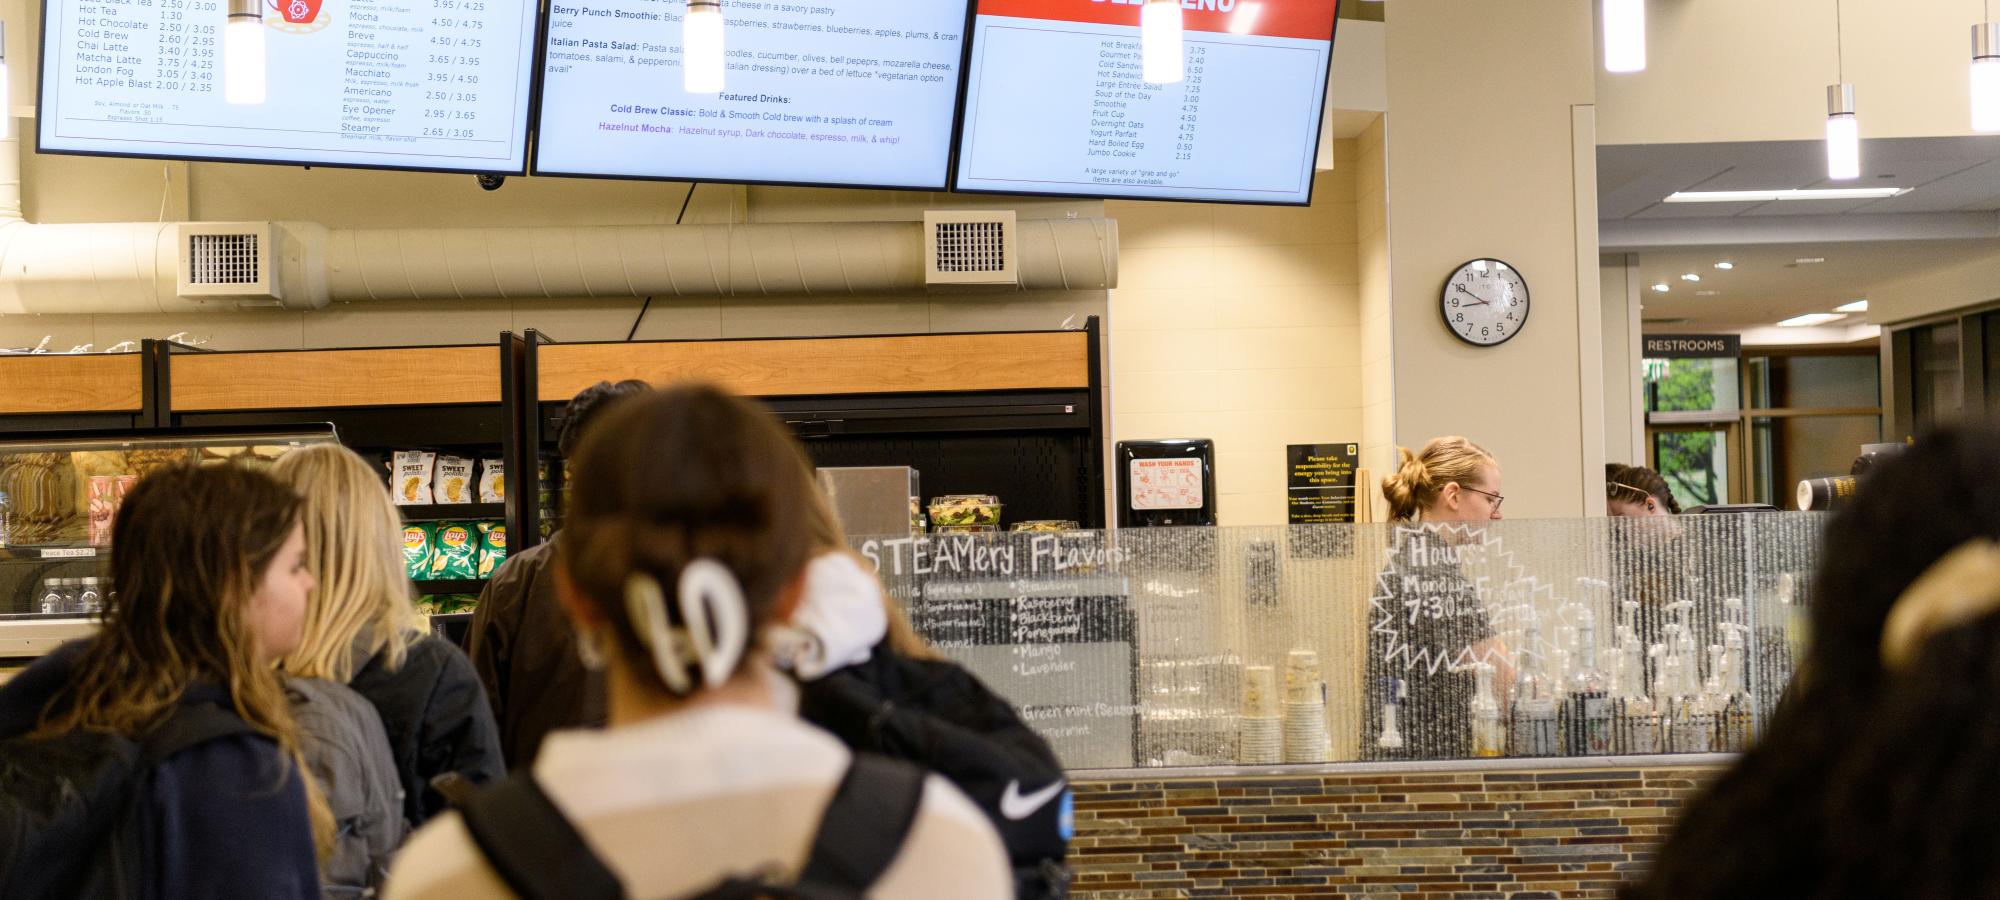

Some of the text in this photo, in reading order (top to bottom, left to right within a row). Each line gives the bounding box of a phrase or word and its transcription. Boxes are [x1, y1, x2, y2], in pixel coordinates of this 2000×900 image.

[80, 5, 182, 20] Hot Tea 1.30
[782, 4, 835, 16] savory pastry
[79, 17, 215, 34] Hot Chocolate 2.50 3.05
[350, 12, 483, 29] Mocha 4.50 4.75
[552, 19, 572, 28] juice
[554, 5, 579, 17] Berry
[582, 8, 611, 17] Punch
[615, 10, 662, 20] Smoothie:
[772, 22, 824, 32] strawberries,
[827, 25, 873, 35] blueberries,
[875, 29, 902, 38] apples,
[78, 29, 214, 46] Cold Brew 2.60 2.95
[348, 31, 375, 40] Breve
[77, 41, 214, 57] Chai Latte 3.40 3.95
[551, 37, 579, 47] Italian
[582, 39, 608, 48] Pasta
[611, 41, 639, 51] Salad:
[643, 43, 667, 53] Pasta
[758, 51, 799, 61] cucumber,
[830, 55, 844, 63] bell
[923, 61, 952, 71] cheese,
[77, 53, 213, 69] Matcha Latte 3.75 4.25
[347, 50, 398, 61] Cappuccino
[1100, 51, 1204, 64] Gourmet 2.40
[77, 65, 212, 80] London Fog 3.05 3.40
[345, 68, 391, 78] Macchiato
[549, 52, 592, 61] tomatoes,
[595, 55, 625, 64] salami,
[920, 74, 944, 83] option
[76, 76, 211, 92] Hot Apple Blast 2.00 2.35
[1096, 80, 1114, 89] Large
[344, 87, 392, 97] Americano
[719, 92, 791, 103] Featured Drinks:
[1095, 90, 1112, 98] Soup
[343, 105, 396, 117] Eye Opener
[611, 104, 632, 114] Cold
[635, 106, 657, 115] Brew
[661, 107, 696, 116] Classic:
[729, 111, 760, 120] Smooth
[763, 112, 781, 121] Cold
[784, 114, 802, 122] brew
[831, 116, 856, 126] splash
[1093, 110, 1108, 118] Fruit
[341, 124, 380, 133] Steamer
[1092, 120, 1125, 129] Overnight
[599, 122, 900, 145] Hazelnut Mocha: Hazelnut Dark chocolate, espresso, whip!
[1090, 129, 1137, 138] Yogurt Parfait
[1108, 140, 1129, 148] Boiled
[1132, 141, 1144, 149] Egg
[1088, 148, 1110, 157] Jumbo
[1467, 273, 1473, 281] 11
[1480, 269, 1489, 277] 12
[1456, 284, 1465, 292] 10
[1509, 283, 1513, 292] 2
[1452, 298, 1459, 307] 9
[1511, 297, 1517, 306] 3
[1456, 313, 1463, 322] 8
[1506, 312, 1513, 320] 4
[1467, 323, 1473, 331] 7
[1482, 327, 1488, 335] 6
[1497, 323, 1503, 331] 5
[1648, 340, 1724, 351] RESTROOMS
[862, 535, 1013, 576] STEAMery
[1411, 536, 1486, 566] Hours:
[1018, 596, 1075, 611] Raspberry
[1019, 613, 1080, 629] Blackberry
[1021, 644, 1060, 659] Mango
[1023, 705, 1061, 720] Green
